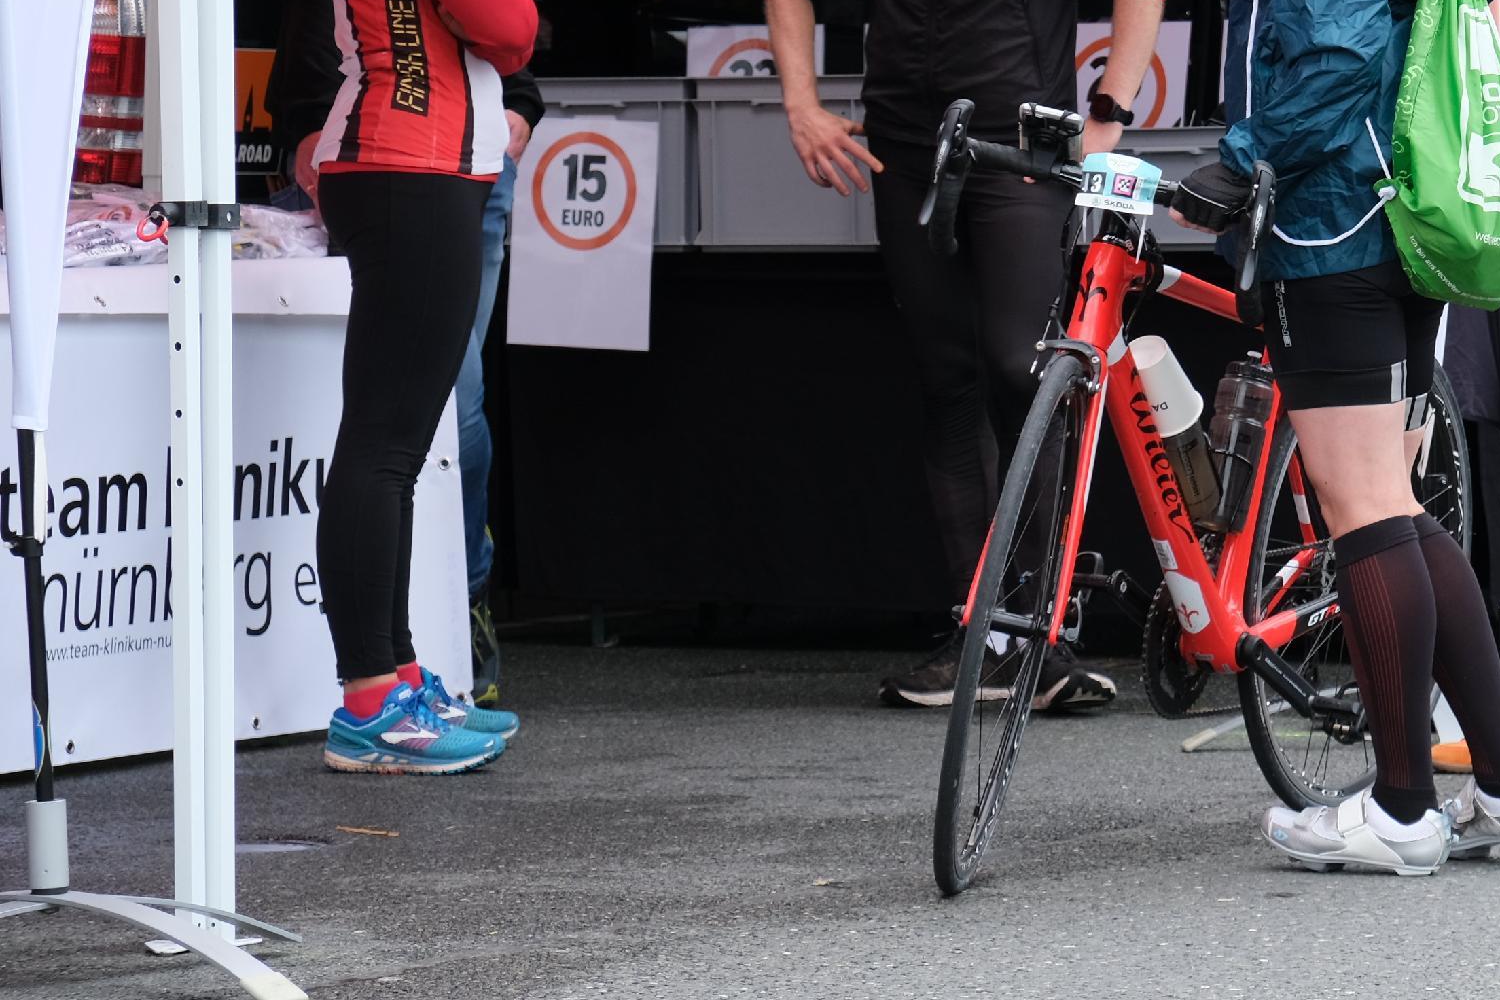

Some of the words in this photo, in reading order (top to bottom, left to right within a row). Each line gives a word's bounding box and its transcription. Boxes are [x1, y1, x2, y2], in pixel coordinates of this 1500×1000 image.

[388, 0, 421, 47] LINE
[562, 153, 607, 203] 15
[561, 208, 604, 228] EURO
[0, 466, 148, 542] tam
